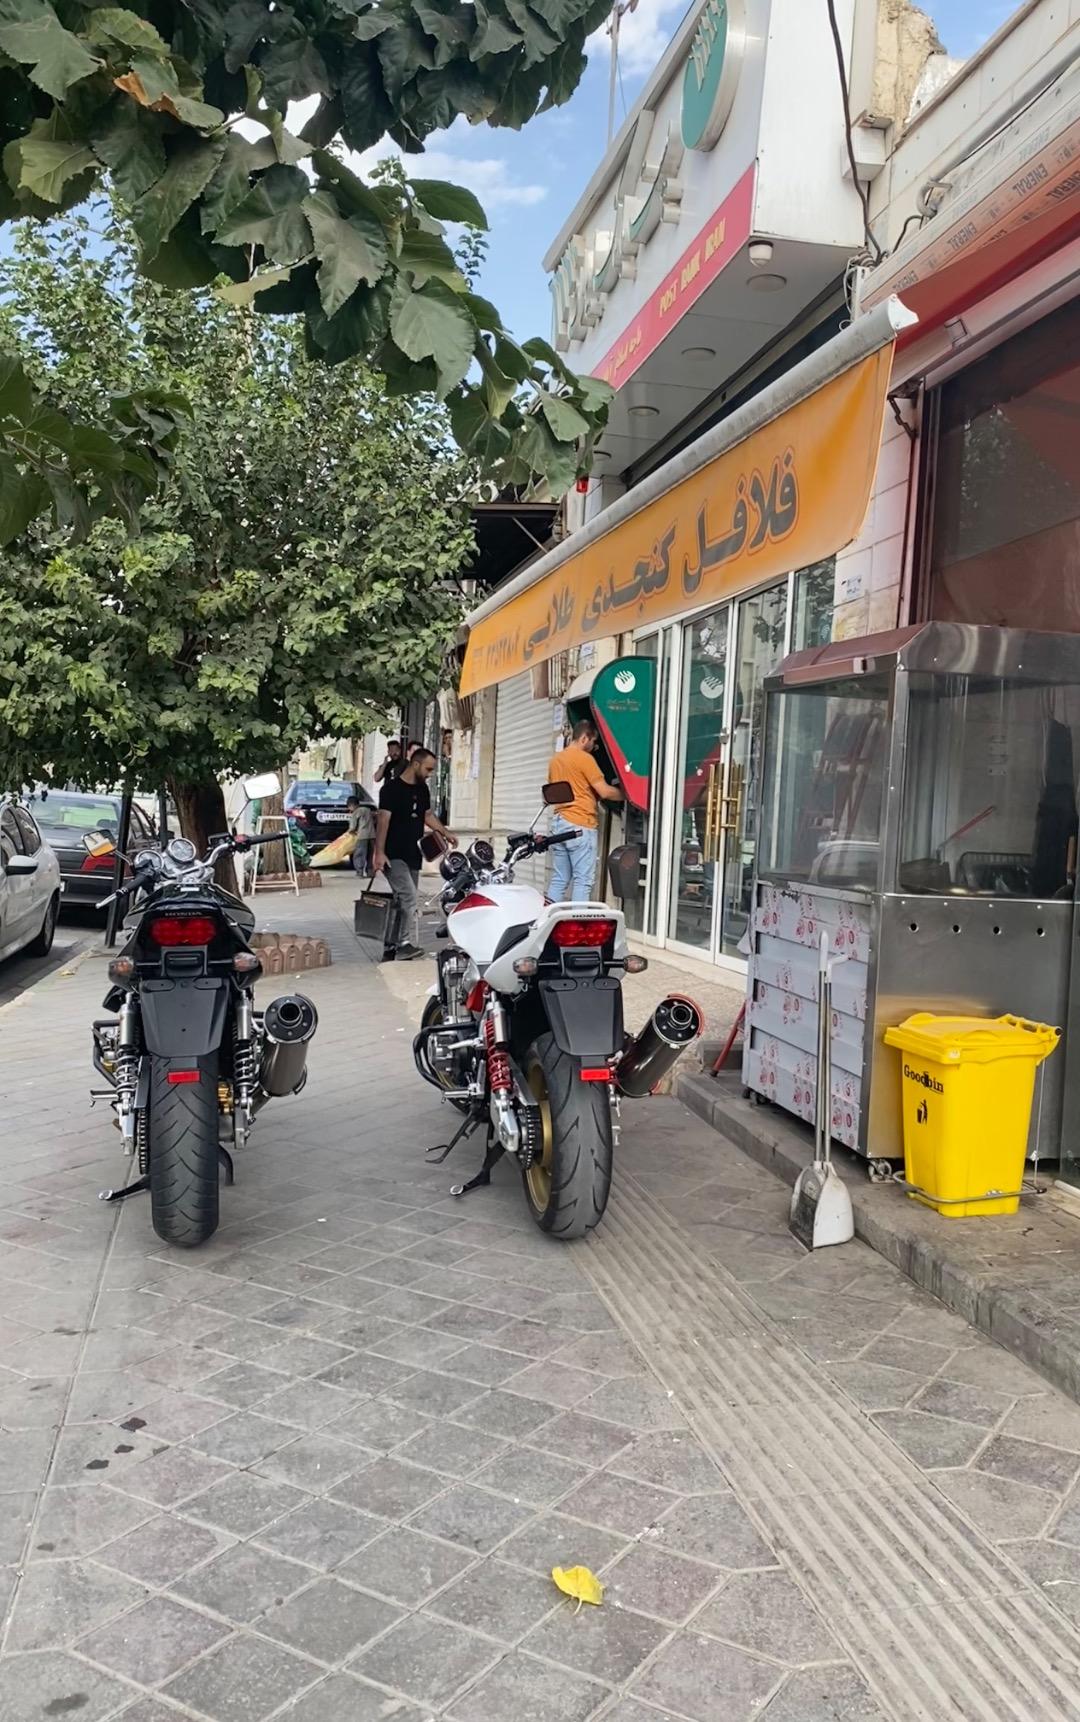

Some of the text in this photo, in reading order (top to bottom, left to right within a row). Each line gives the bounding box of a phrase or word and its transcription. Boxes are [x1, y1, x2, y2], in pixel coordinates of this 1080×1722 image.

[1011, 162, 1049, 197] ENERAL
[659, 281, 678, 318] POST
[682, 447, 798, 596] فلافل
[581, 521, 677, 632] کنجدی
